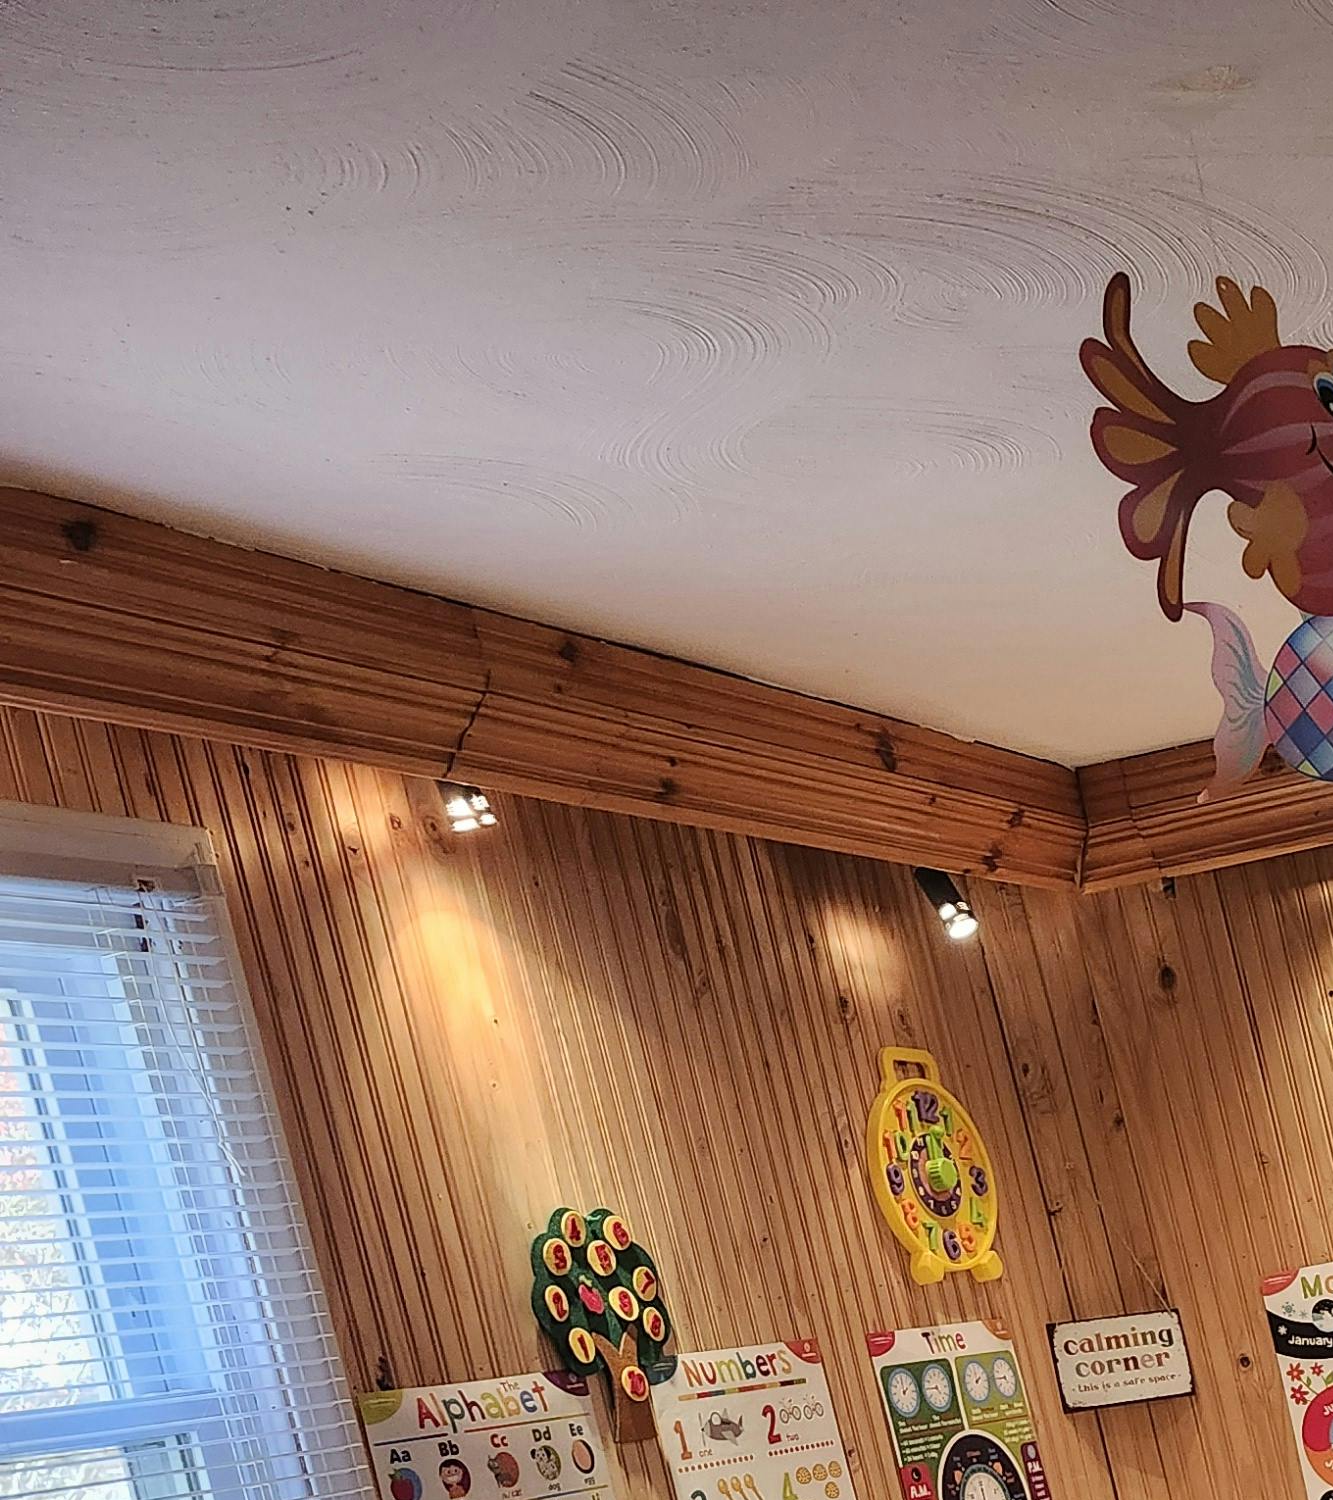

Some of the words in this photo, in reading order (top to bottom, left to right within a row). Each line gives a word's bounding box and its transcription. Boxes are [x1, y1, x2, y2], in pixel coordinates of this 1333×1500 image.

[920, 1329, 967, 1356] Time
[1063, 1326, 1175, 1356] calming
[1287, 1334, 1333, 1348] January
[681, 1350, 792, 1388] Numbers
[1075, 1351, 1171, 1378] corner
[499, 1379, 520, 1392] The
[1077, 1382, 1100, 1393] this
[1102, 1382, 1111, 1392] is
[1113, 1380, 1121, 1388] a
[1123, 1376, 1146, 1386] safe
[1148, 1373, 1177, 1384] space
[415, 1380, 549, 1433] Alphabet
